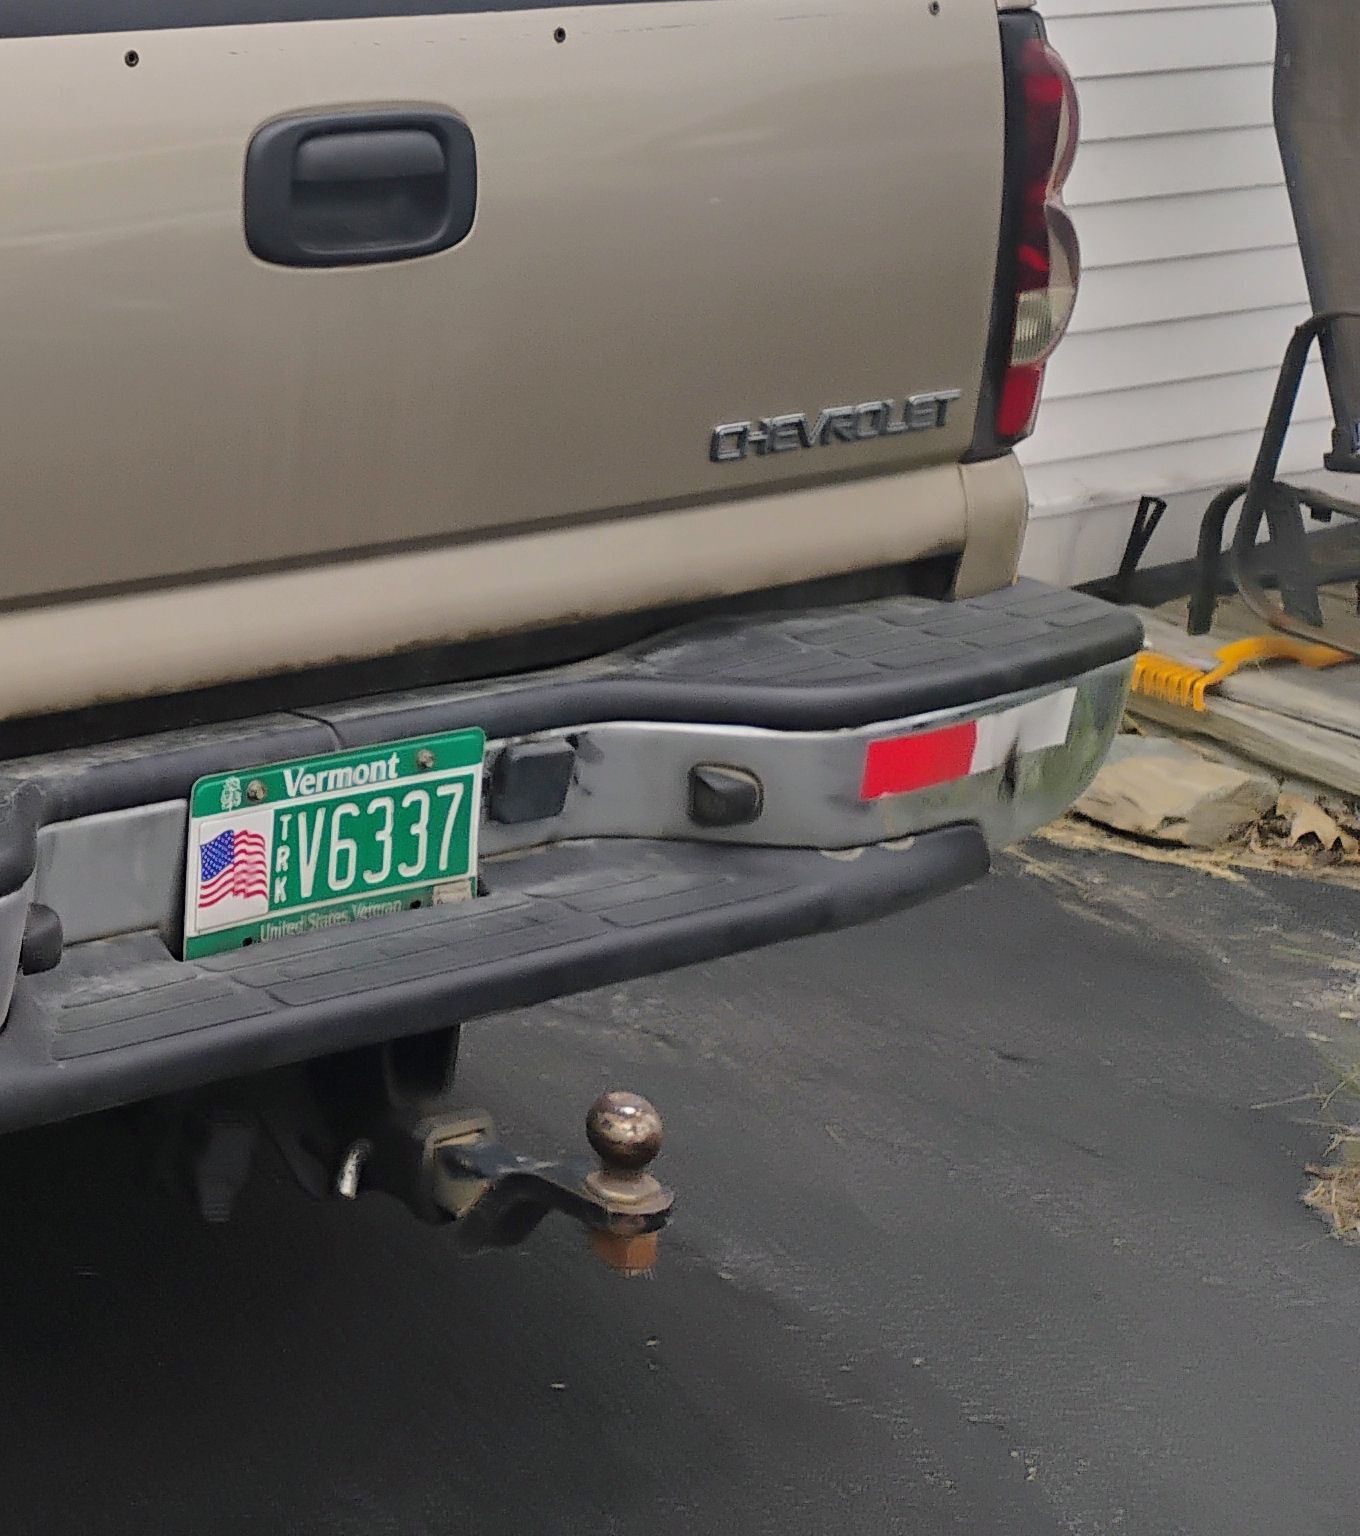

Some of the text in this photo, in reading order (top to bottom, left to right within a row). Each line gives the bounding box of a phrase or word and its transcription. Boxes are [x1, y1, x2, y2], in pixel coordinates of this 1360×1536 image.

[709, 389, 962, 462] CHEVROLET
[283, 751, 401, 797] Vermont
[274, 814, 293, 904] TRK
[296, 782, 465, 899] V6337
